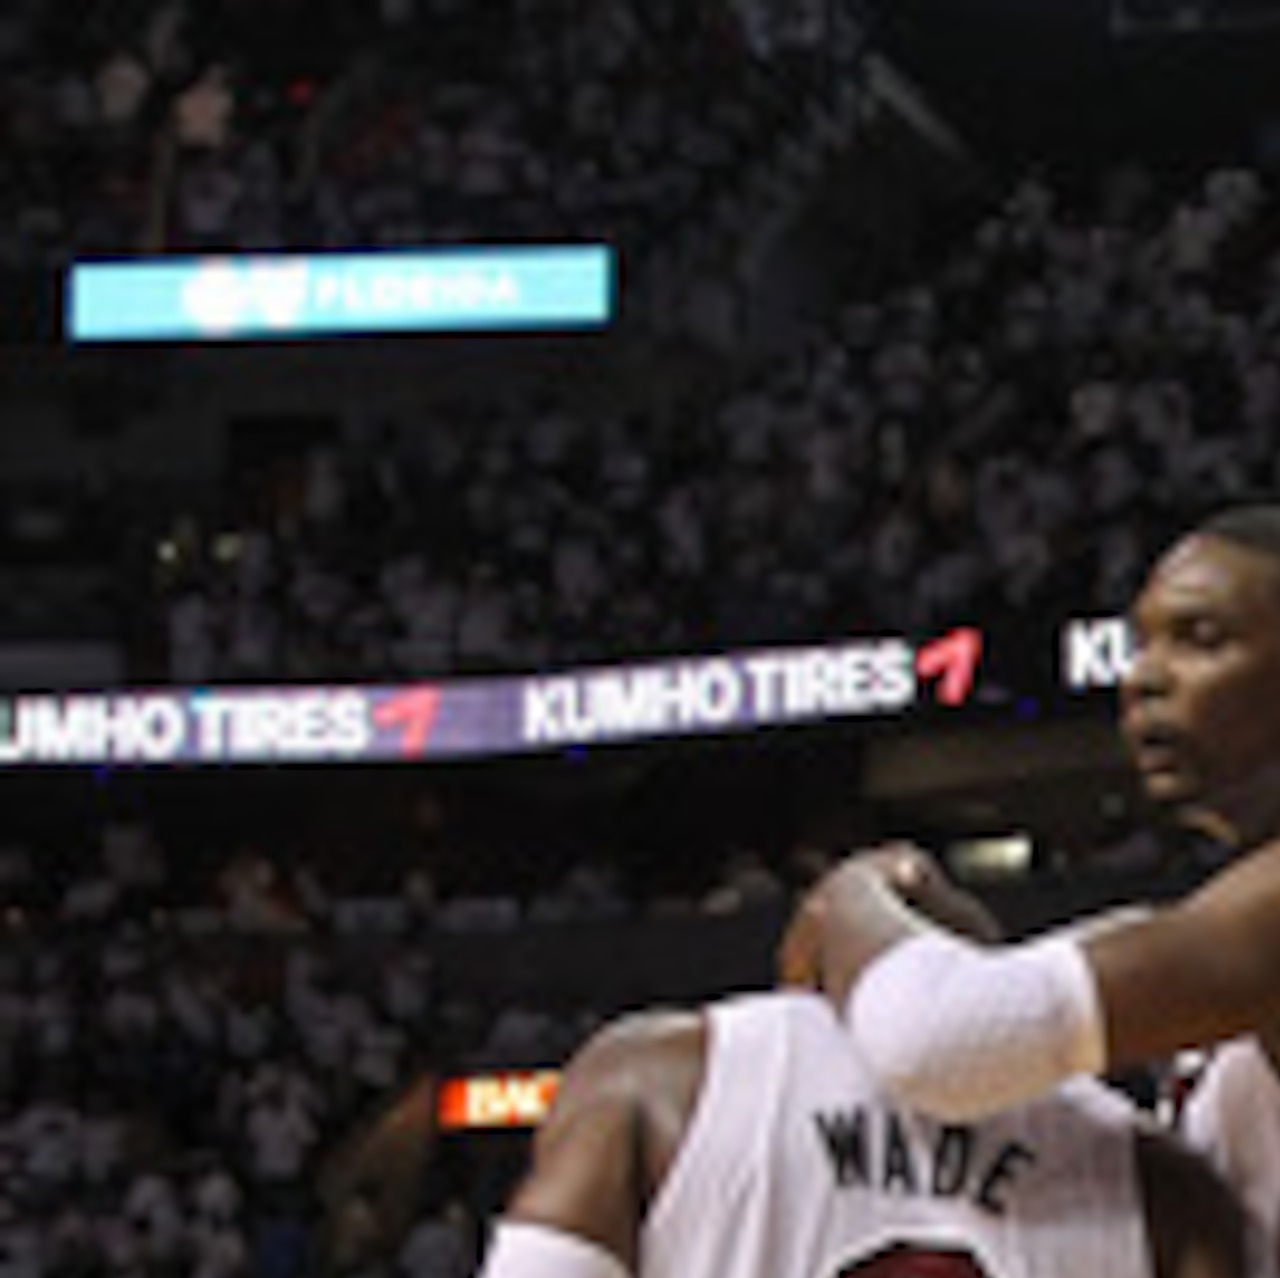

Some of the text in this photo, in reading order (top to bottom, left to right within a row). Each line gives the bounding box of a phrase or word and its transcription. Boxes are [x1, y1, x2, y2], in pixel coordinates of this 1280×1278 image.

[0, 689, 373, 763] UMHO TIRES
[523, 637, 915, 743] KUMHO TIRES
[814, 1104, 1036, 1217] WADE
